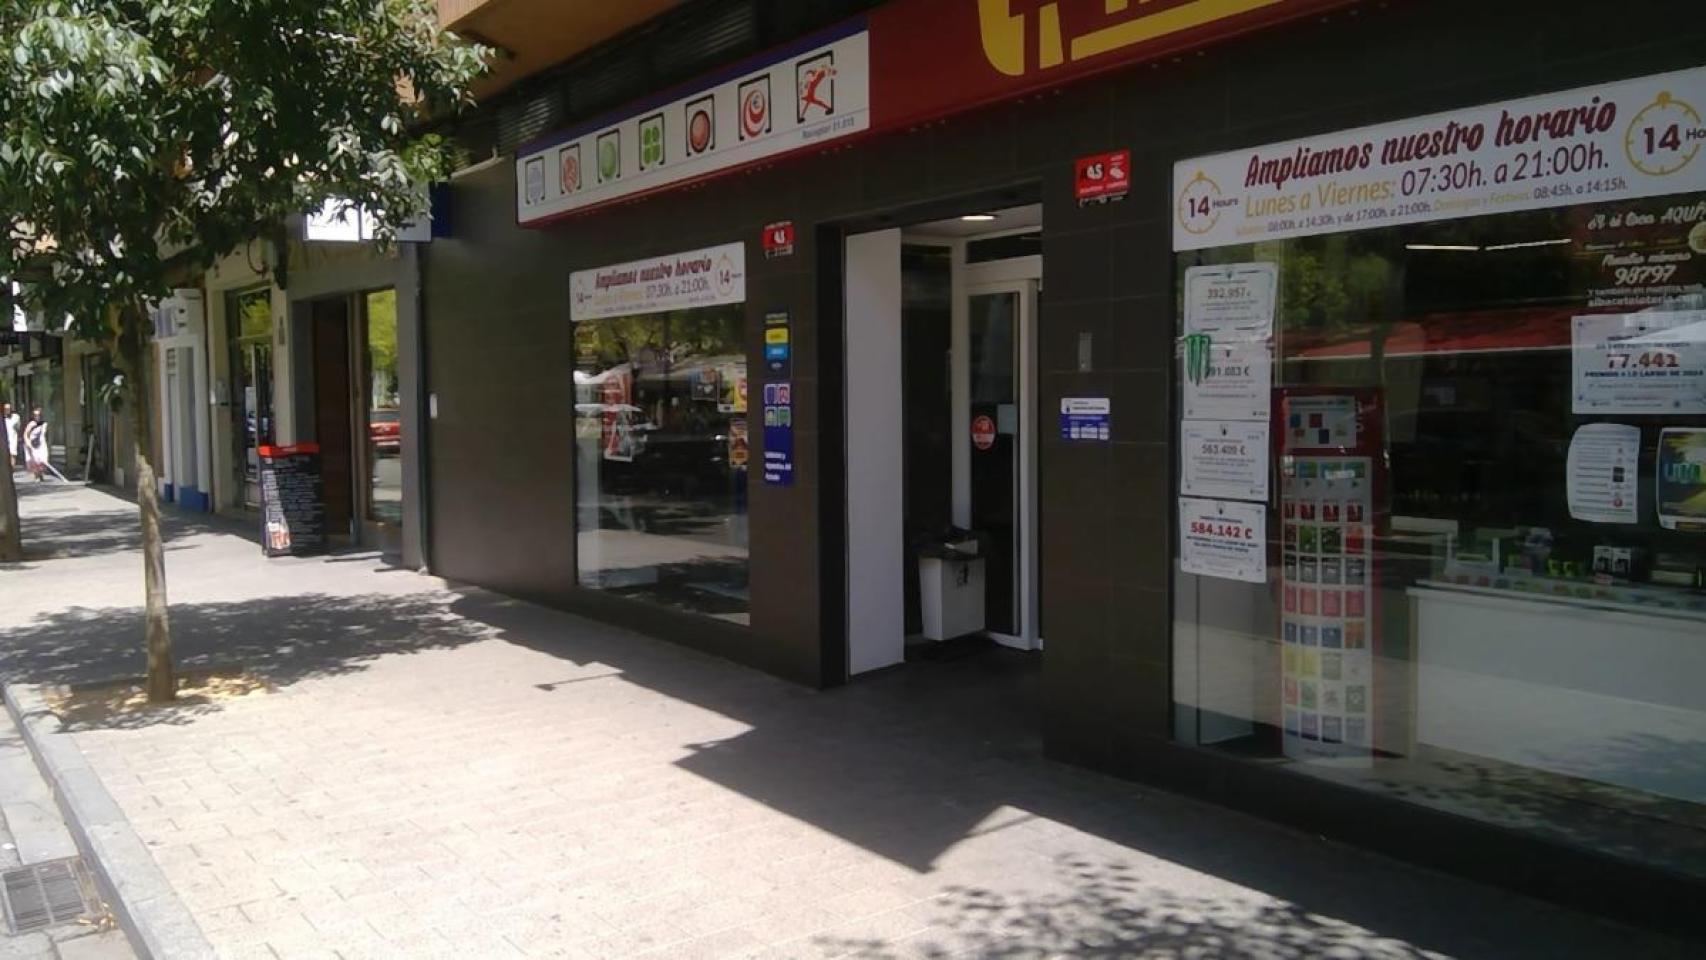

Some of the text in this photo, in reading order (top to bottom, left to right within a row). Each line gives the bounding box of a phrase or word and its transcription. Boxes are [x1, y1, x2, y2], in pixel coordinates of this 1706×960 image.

[1245, 96, 1617, 190] Ampliamos nuestro horario
[1643, 124, 1682, 155] 14
[1245, 141, 1610, 218] Lunes a Viernes: 07:30h. a 21:00h.
[1587, 176, 1628, 194] 14:15h.
[1188, 195, 1209, 218] 14
[675, 253, 712, 276] horario
[1614, 264, 1678, 285] 98797
[719, 269, 730, 286] 14
[1190, 521, 1242, 538] 584.142
